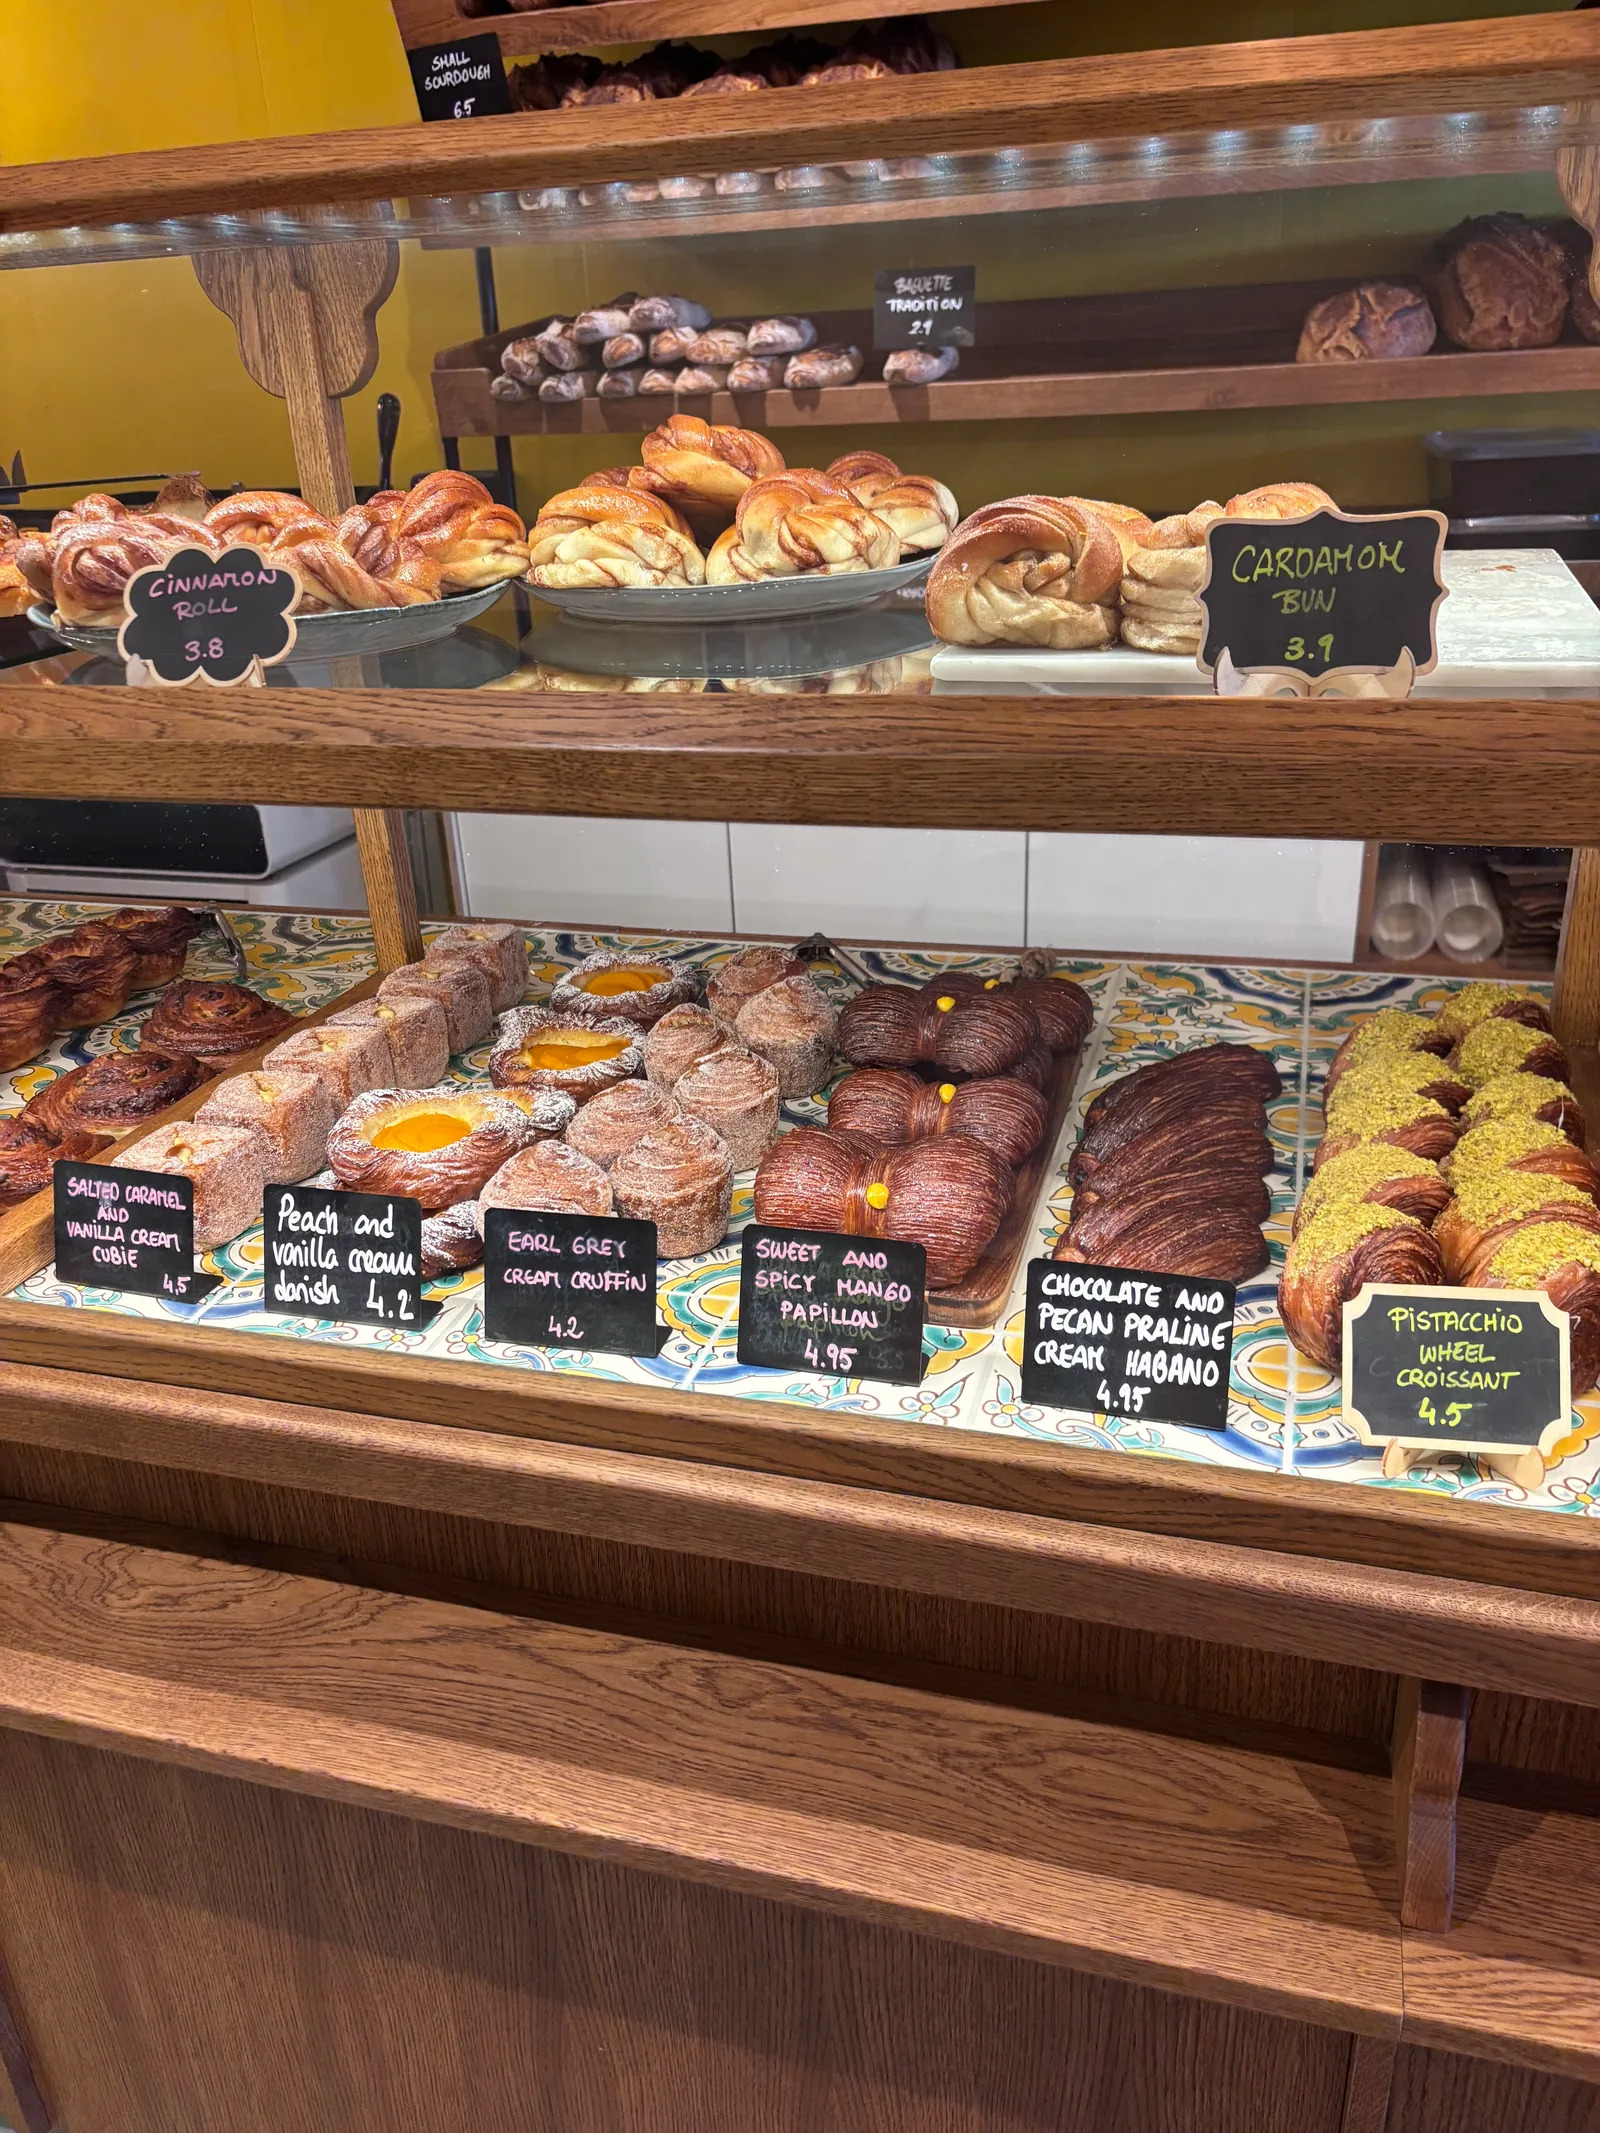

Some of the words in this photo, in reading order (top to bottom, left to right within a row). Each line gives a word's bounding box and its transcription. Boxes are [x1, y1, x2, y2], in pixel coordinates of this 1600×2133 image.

[431, 51, 471, 72] SMALL
[424, 63, 491, 91] SOURDOUGH
[172, 597, 238, 621] ROLL
[1271, 587, 1336, 614] BUN
[184, 637, 224, 662] 3.8
[1284, 633, 1335, 662] 3.9
[67, 1176, 120, 1201] SALTED
[125, 1185, 187, 1211] CARAMEL
[97, 1205, 130, 1223] AND
[277, 1192, 339, 1236] Peach
[354, 1203, 395, 1239] and
[66, 1219, 126, 1243] VANILLA
[131, 1228, 181, 1253] CREAM
[508, 1231, 561, 1254] EARL
[572, 1236, 627, 1259] GREY
[272, 1235, 340, 1270] vanilla
[348, 1248, 416, 1276] cream
[755, 1238, 822, 1262] SWEET
[842, 1250, 888, 1270] AND
[503, 1268, 561, 1289] CREAM
[570, 1270, 647, 1292] CRUFFIN
[754, 1269, 817, 1293] SPICY
[836, 1278, 912, 1303] MANGO
[1041, 1272, 1162, 1308] CHOCOLATE
[1174, 1288, 1225, 1315] AND
[274, 1269, 341, 1305] danish
[366, 1278, 415, 1321] 4.2
[548, 1315, 584, 1339] 4.2
[780, 1300, 879, 1329] PAPILLON
[1037, 1302, 1114, 1336] PECAN
[1123, 1312, 1233, 1351] PRALINE
[1387, 1306, 1523, 1335] PISTACCHIO
[803, 1338, 858, 1371] 4.95
[1033, 1339, 1106, 1372] CREAM
[1125, 1349, 1220, 1388] HABANO
[1419, 1341, 1497, 1365] WHEEL
[1396, 1365, 1521, 1390] CROISSANT
[1096, 1379, 1152, 1413] 4.95
[1418, 1396, 1473, 1427] 4.5
